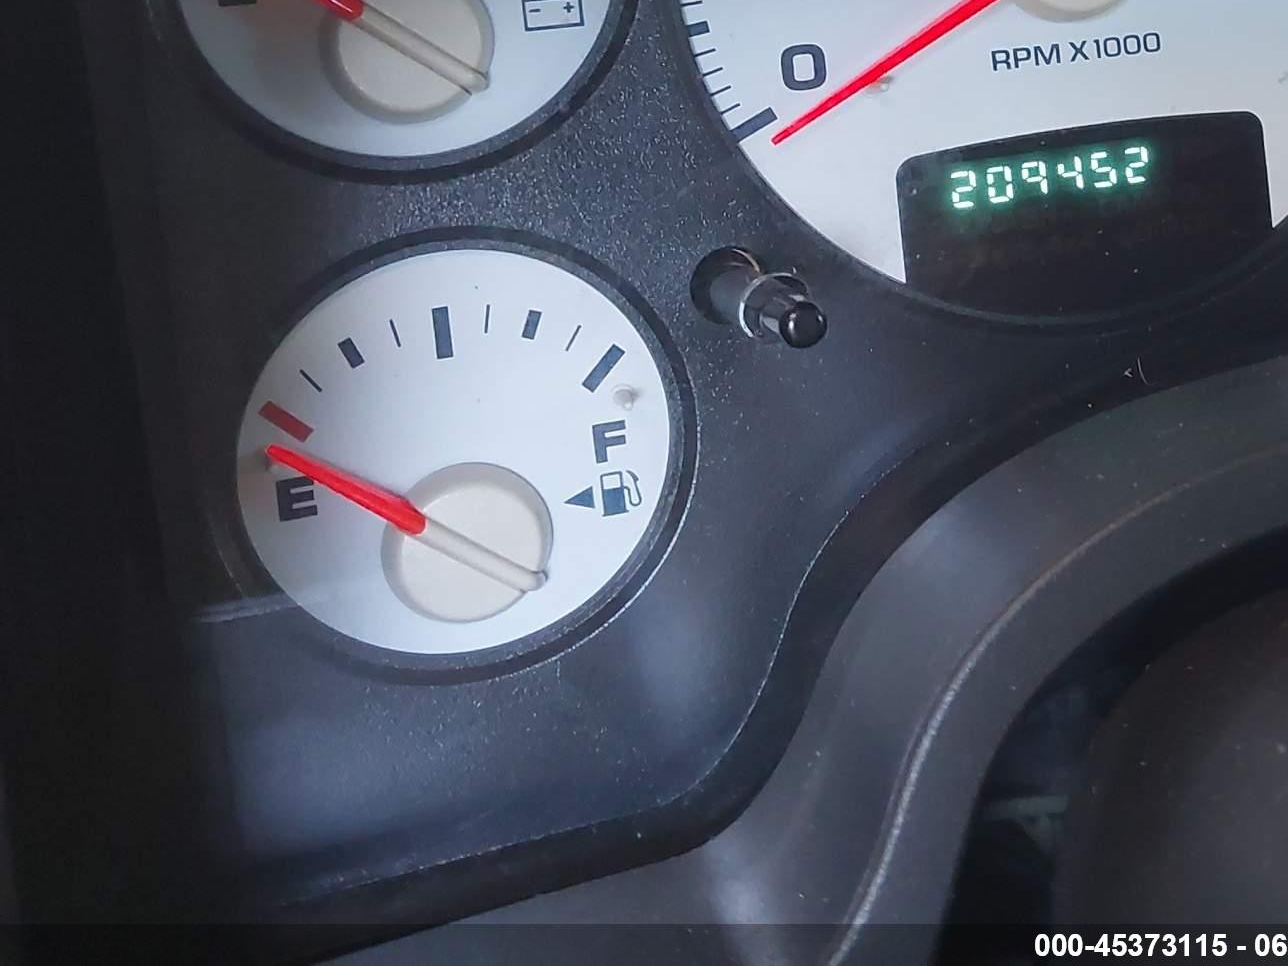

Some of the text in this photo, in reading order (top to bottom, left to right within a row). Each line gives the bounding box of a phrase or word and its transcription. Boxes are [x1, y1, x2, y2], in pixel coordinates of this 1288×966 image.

[780, 43, 827, 91] 0
[991, 43, 1062, 71] RPM
[950, 146, 1149, 209] 209452
[592, 420, 627, 463] F
[276, 477, 318, 522] E
